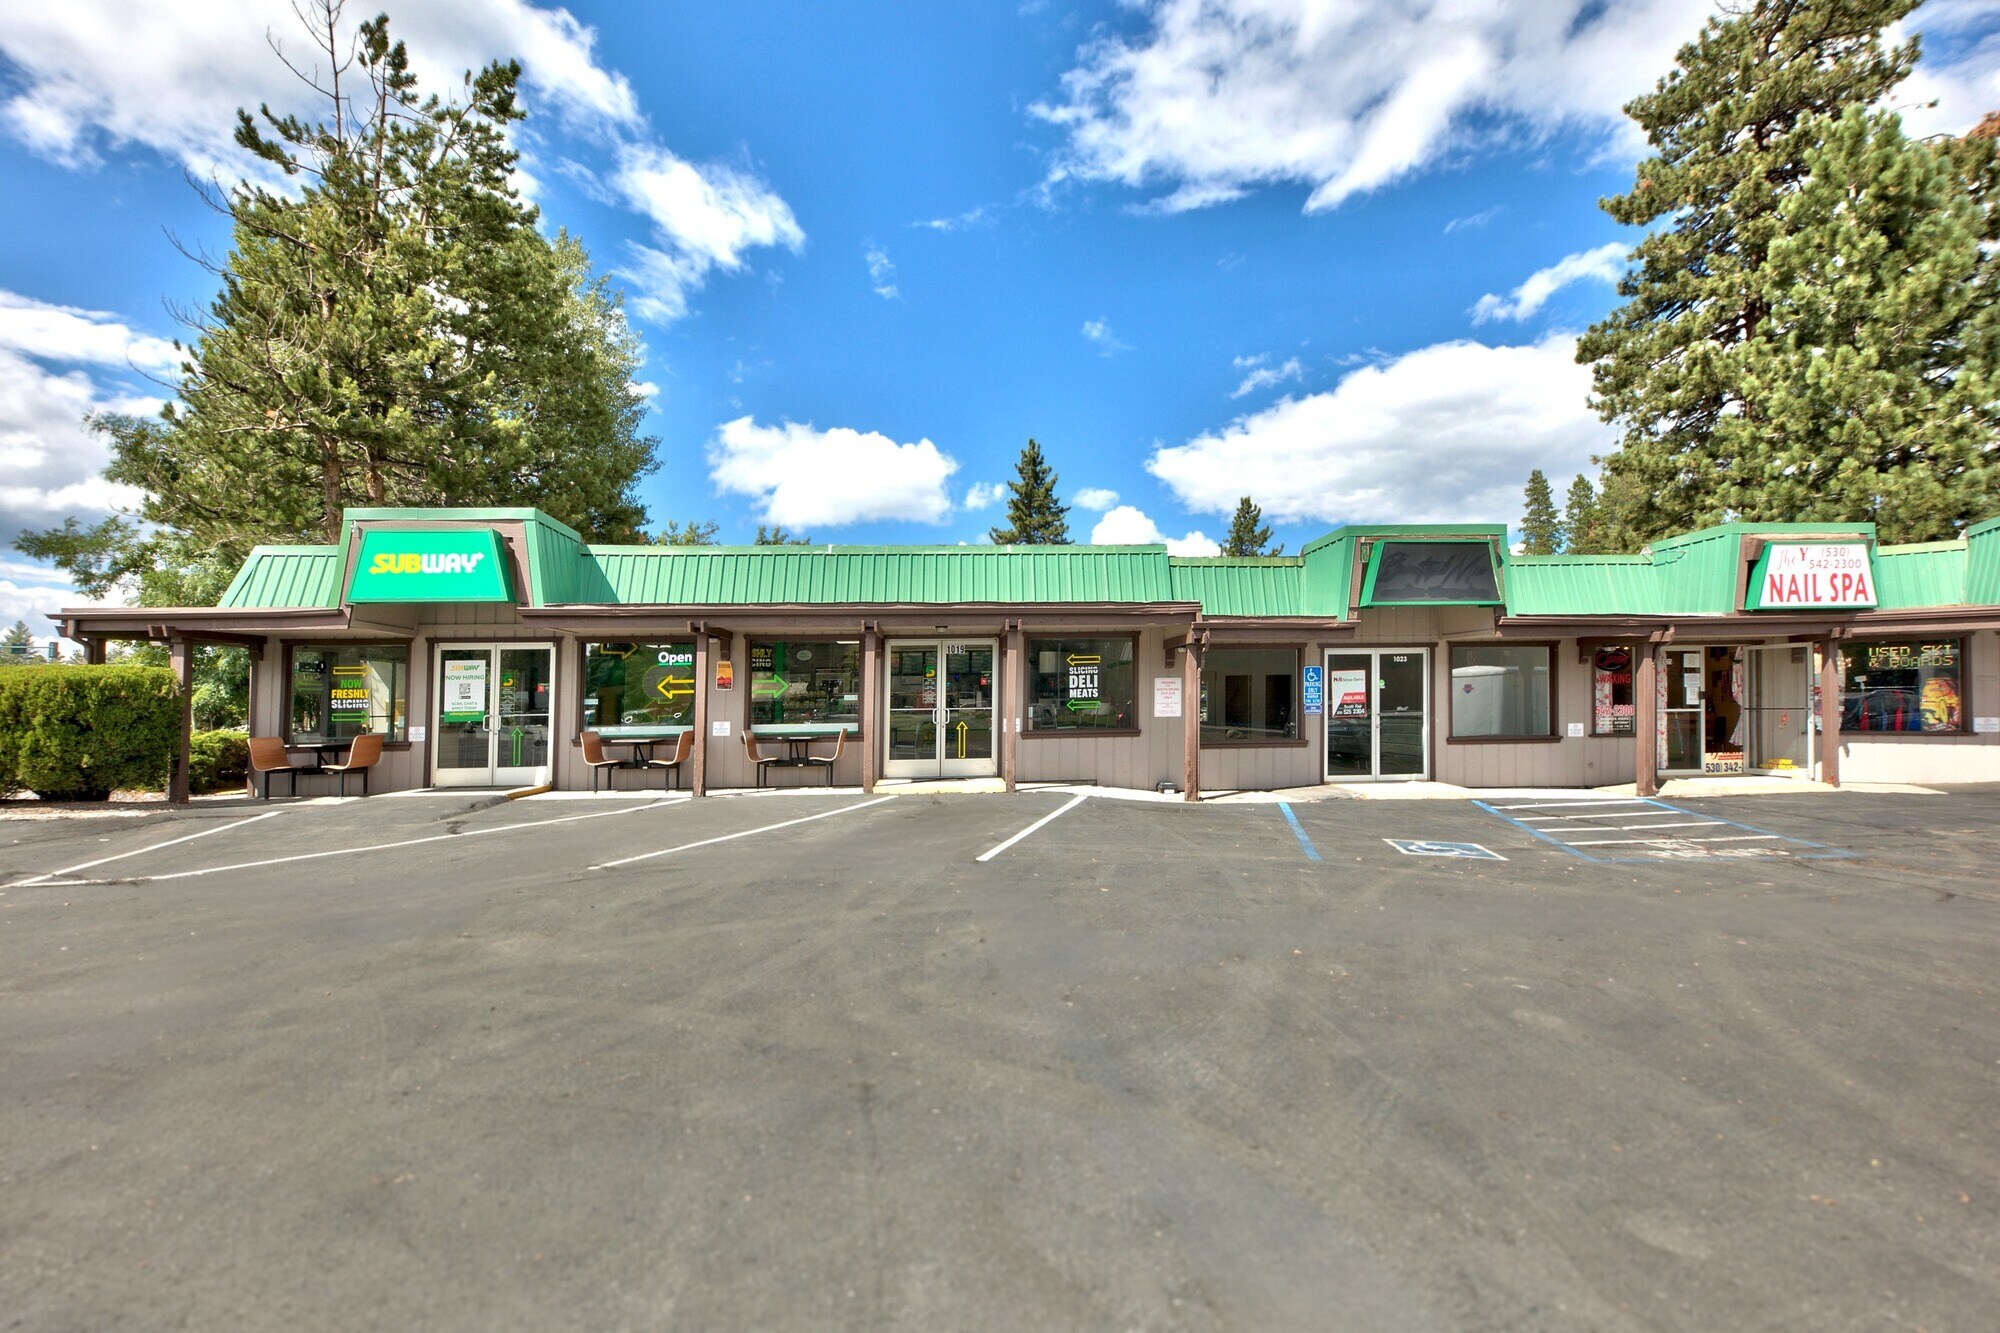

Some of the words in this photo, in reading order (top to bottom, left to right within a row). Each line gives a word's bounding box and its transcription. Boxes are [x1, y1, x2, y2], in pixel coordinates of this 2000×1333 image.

[1821, 547, 1850, 558] (530)
[368, 551, 485, 574] SUBWAY
[1809, 559, 1862, 569] 542-2300
[1769, 573, 1822, 602] NAIL
[1829, 573, 1869, 602] SPA
[947, 645, 965, 654] 1019
[1869, 646, 1910, 657] USED
[1921, 644, 1953, 656] SKI
[658, 651, 692, 666] Open
[1889, 655, 1954, 668] BOARDS
[1069, 666, 1098, 674] SLICING
[340, 680, 362, 688] NOW
[1069, 675, 1098, 688] DELI
[1600, 673, 1632, 684] WAXING
[331, 689, 370, 699] FRESHLY
[1069, 688, 1099, 698] MEATS
[331, 699, 370, 709] SLICING
[1596, 705, 1635, 716] 542-2300
[1723, 761, 1743, 772] 342-
